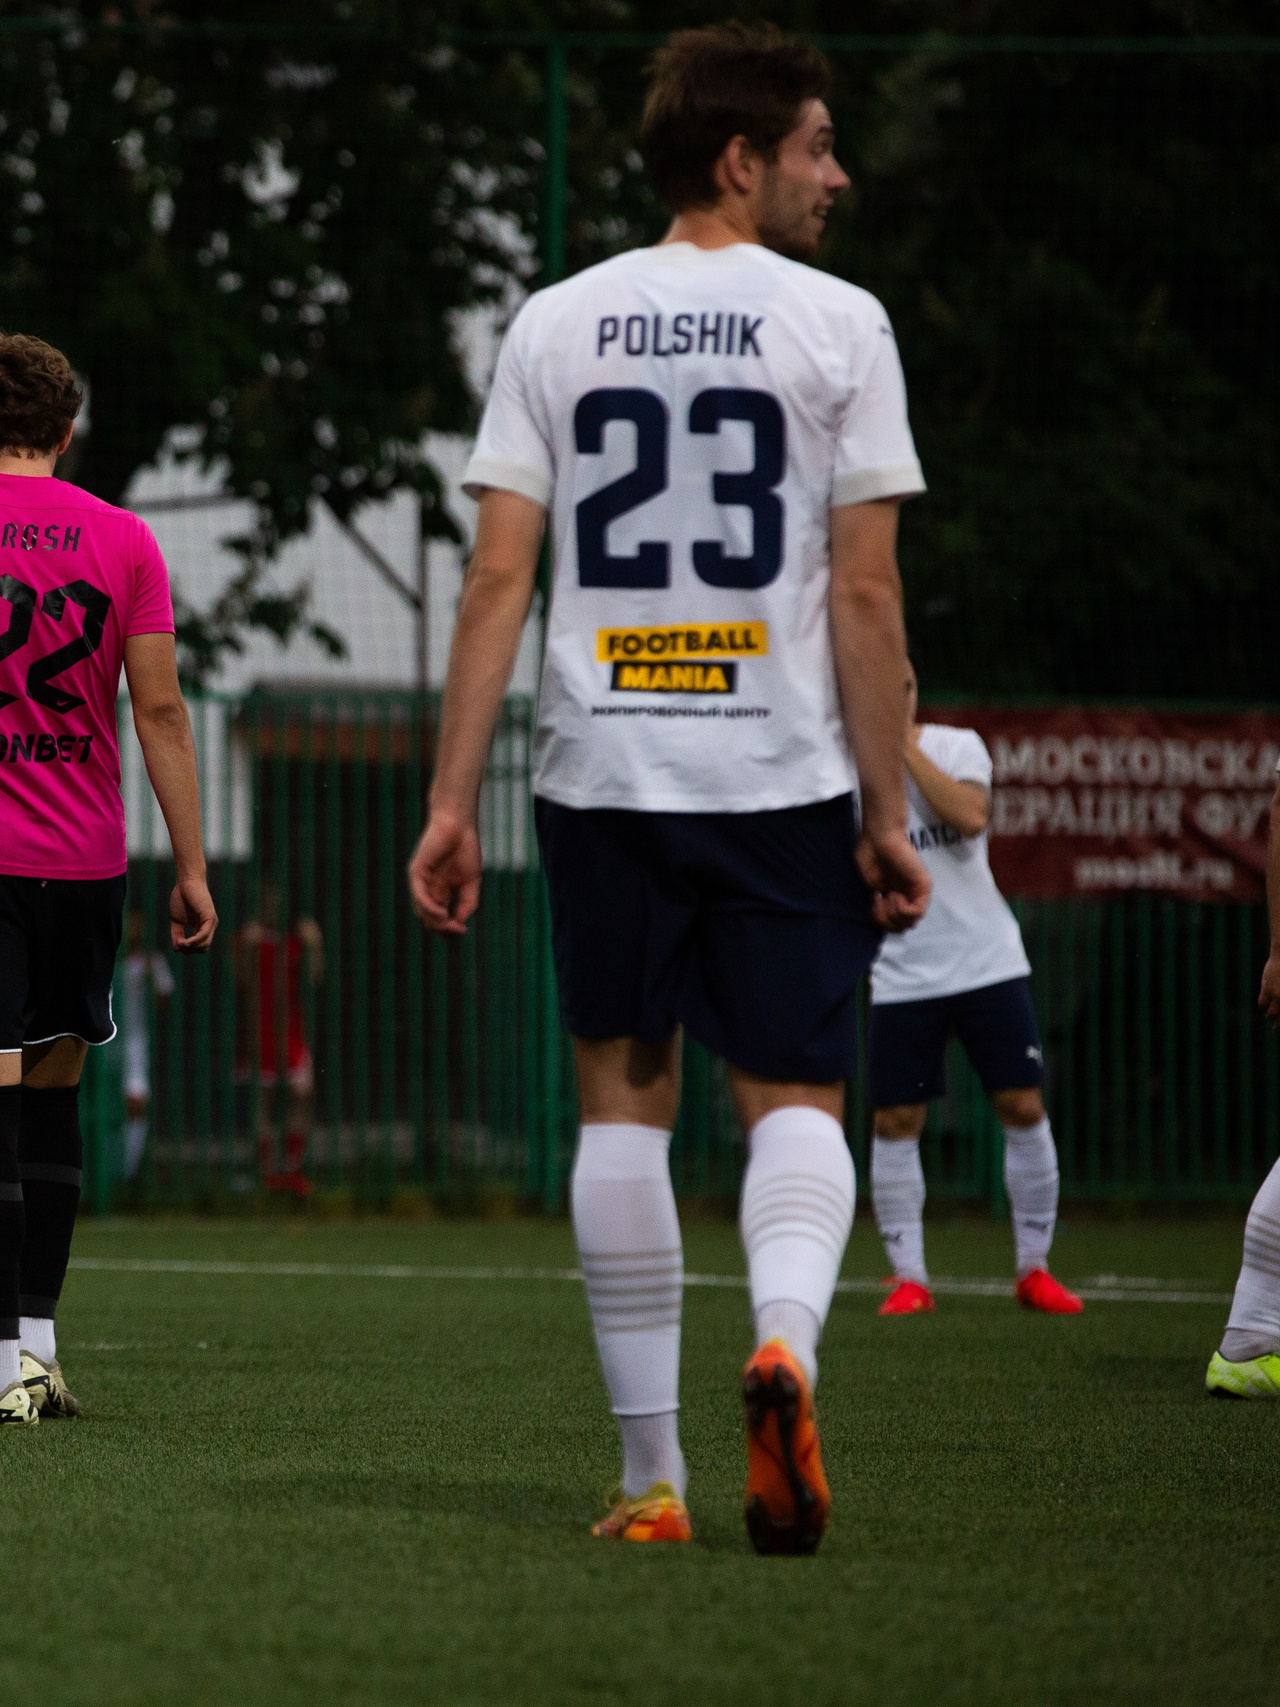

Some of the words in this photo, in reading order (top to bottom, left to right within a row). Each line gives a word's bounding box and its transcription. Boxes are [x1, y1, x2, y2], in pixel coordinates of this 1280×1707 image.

[598, 312, 766, 357] POLSHIK
[574, 386, 786, 590] 23
[607, 628, 758, 655] FOOTBALL
[618, 664, 729, 692] MANIA
